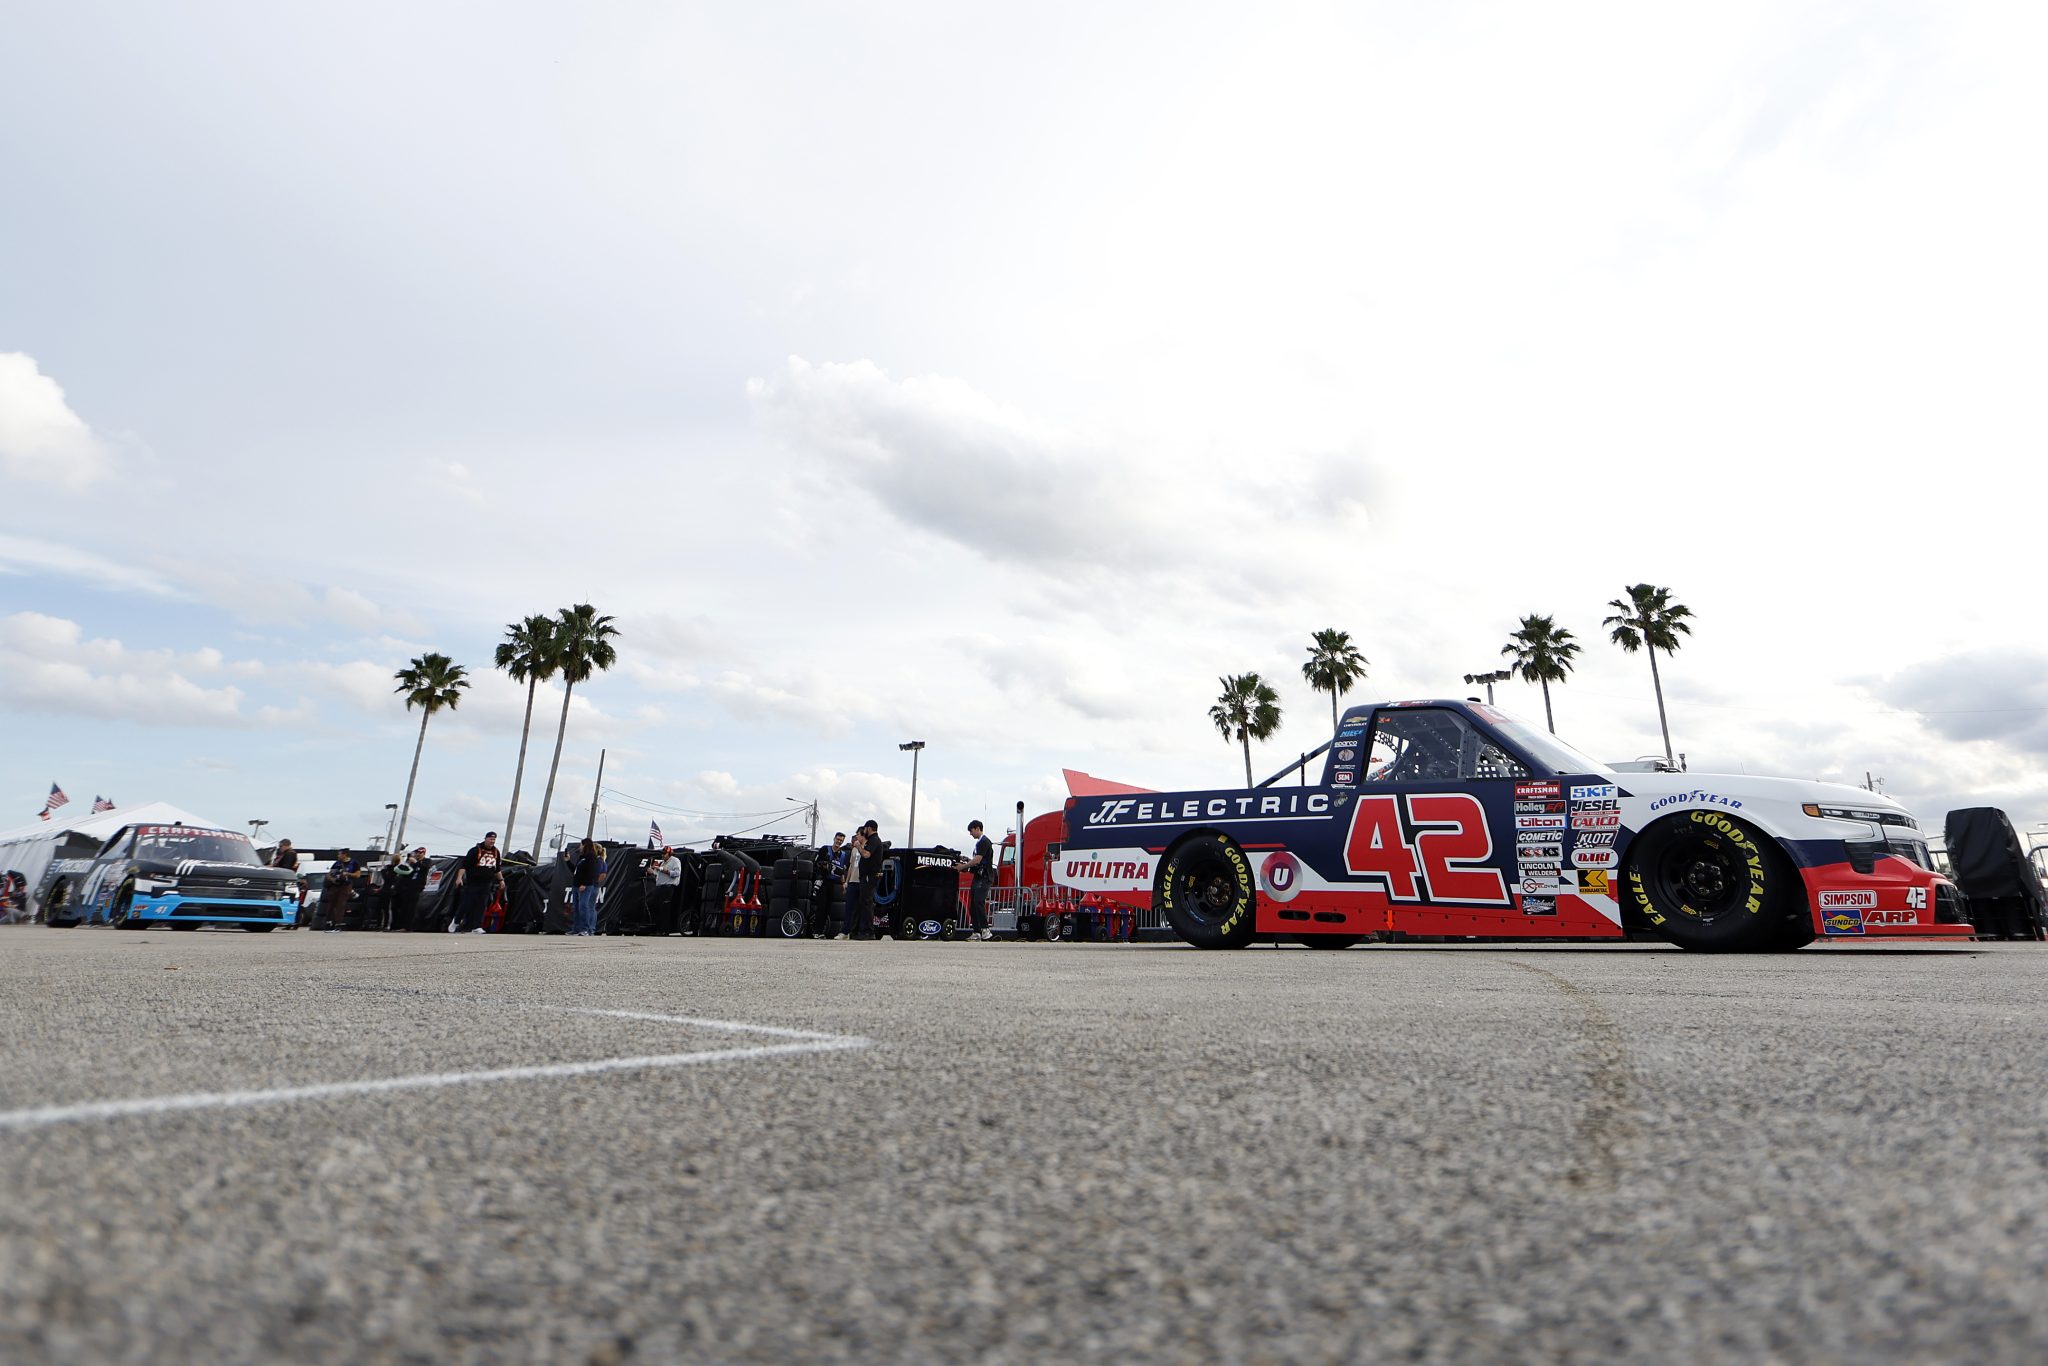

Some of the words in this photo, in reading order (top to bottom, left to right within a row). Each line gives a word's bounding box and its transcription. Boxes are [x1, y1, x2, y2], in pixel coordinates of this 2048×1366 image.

[1516, 786, 1558, 794] CRAFTSMAN
[1572, 786, 1616, 798] SKF
[1136, 794, 1329, 820] ELECTRIC
[1571, 799, 1621, 811] JESEL
[1650, 789, 1743, 811] GOODYEAR
[1515, 802, 1546, 814] Holley
[1519, 817, 1563, 827] tilton
[1572, 816, 1619, 827] CALICO
[147, 825, 249, 841] CRAFTSMAN
[1518, 830, 1563, 841] COMETIC
[1579, 833, 1614, 844] KLOTZ
[1343, 793, 1511, 905] 42
[917, 856, 955, 868] MENARD
[1690, 810, 1765, 914] GOODYEAR
[1066, 861, 1149, 879] UTILITRA
[1273, 867, 1290, 886] U
[1163, 862, 1176, 909] EAGLE
[1224, 846, 1250, 935] GOODYEAR
[1629, 871, 1667, 926] EAGLE
[1823, 893, 1872, 906] SIMPSON
[1906, 887, 1927, 909] 42
[1866, 910, 1918, 924] ARP
